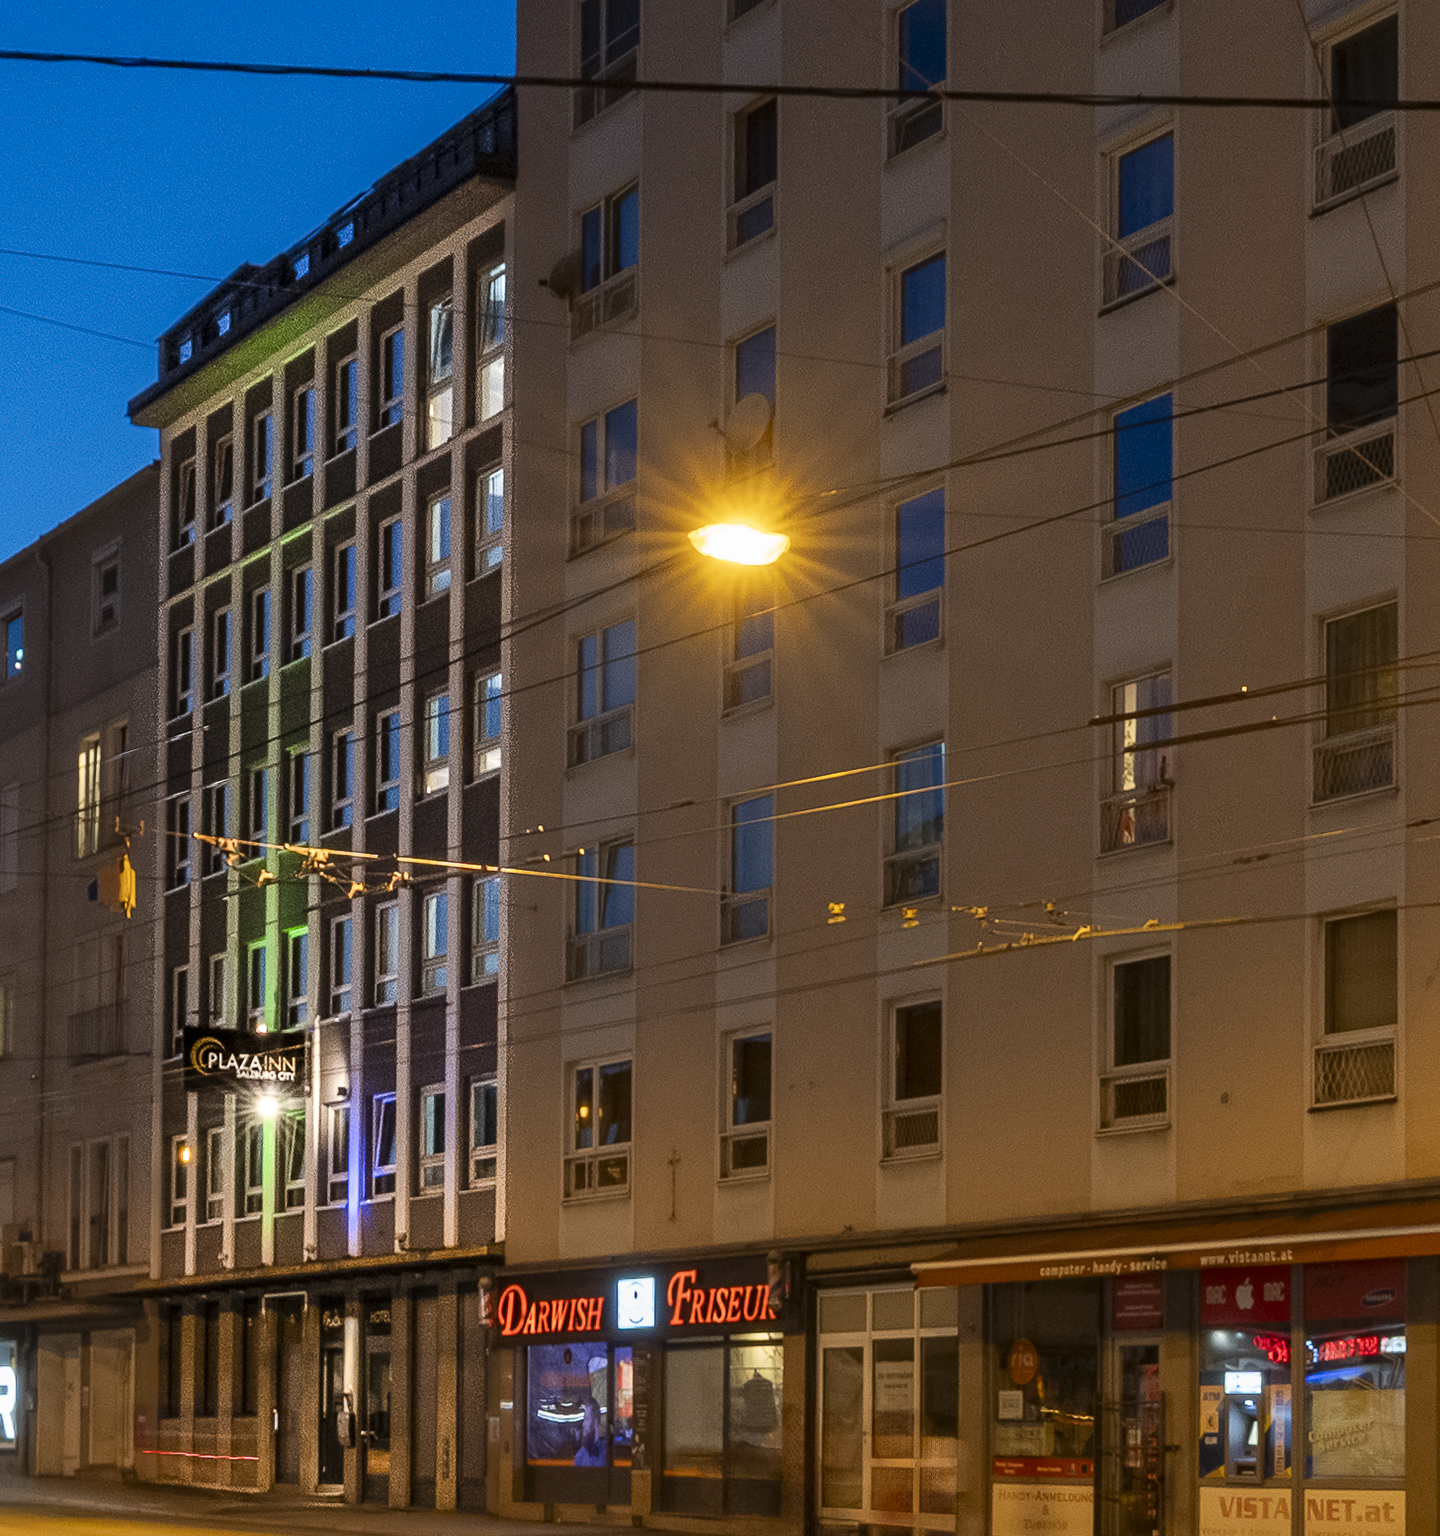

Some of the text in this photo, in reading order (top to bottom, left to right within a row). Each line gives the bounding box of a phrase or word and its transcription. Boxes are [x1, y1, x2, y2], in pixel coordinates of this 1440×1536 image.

[208, 1052, 296, 1076] PLAZA INN
[1039, 1264, 1086, 1279] computer
[1092, 1259, 1122, 1275] handy
[1129, 1257, 1168, 1272] service
[1200, 1249, 1294, 1267] www.vistanet.at
[497, 1283, 605, 1336] DARWISH
[1219, 1496, 1396, 1523] VISTA NET.at
